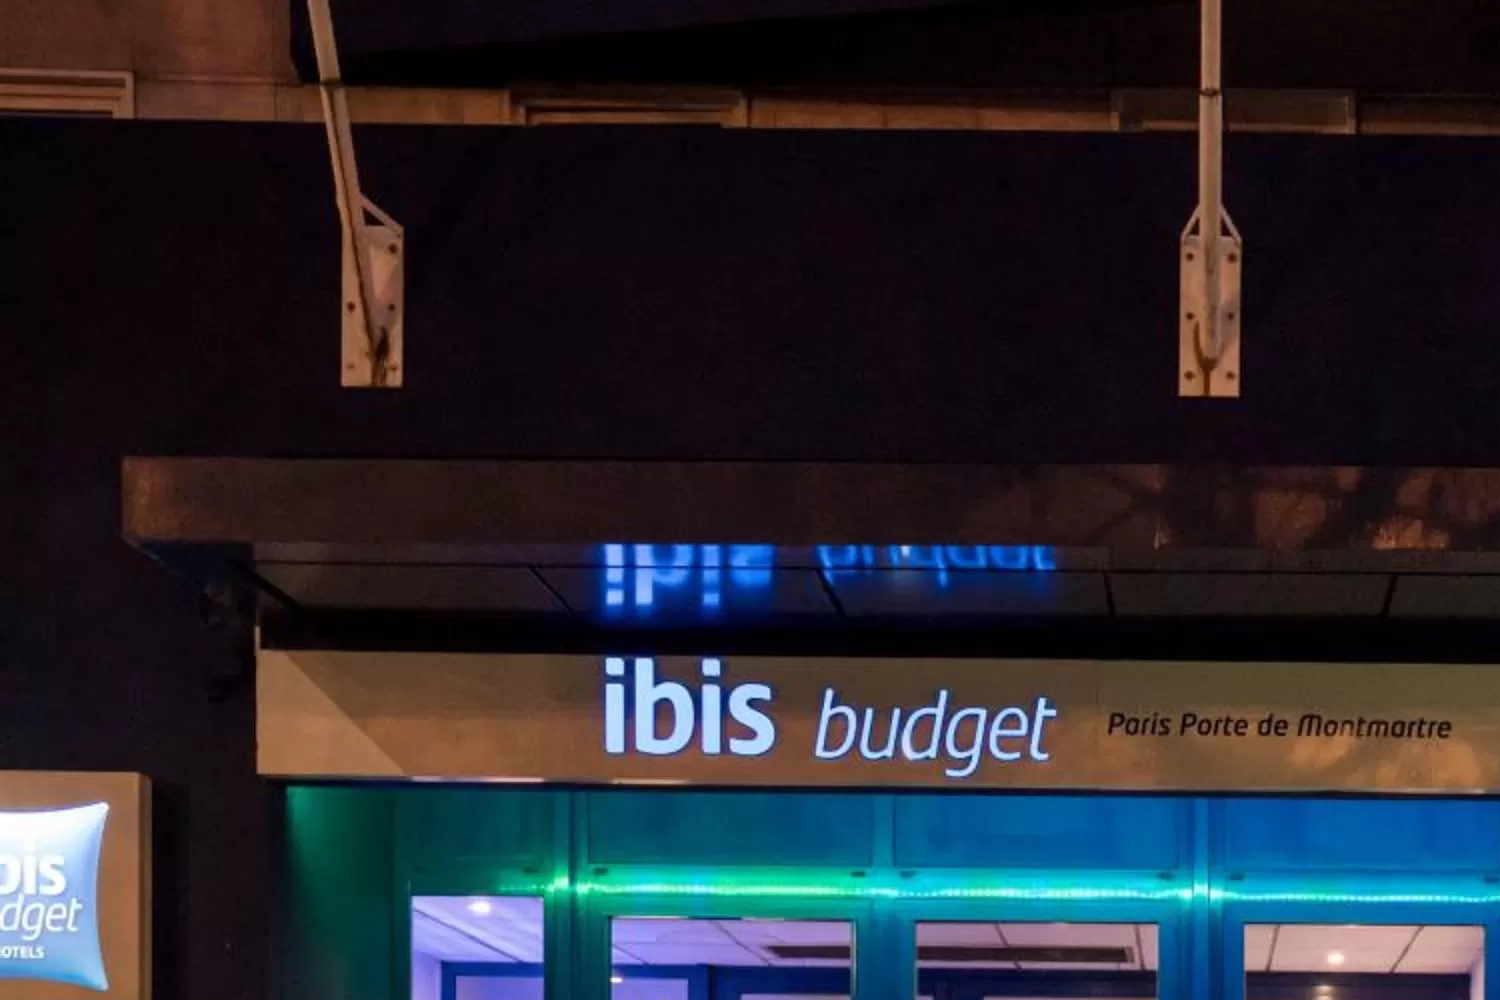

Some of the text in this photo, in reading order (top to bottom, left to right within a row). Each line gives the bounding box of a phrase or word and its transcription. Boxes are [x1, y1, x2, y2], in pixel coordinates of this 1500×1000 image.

[605, 657, 1057, 777] ibis budget
[1107, 712, 1453, 739] Paris Porte de Montmartre
[0, 945, 45, 959] OTELS
